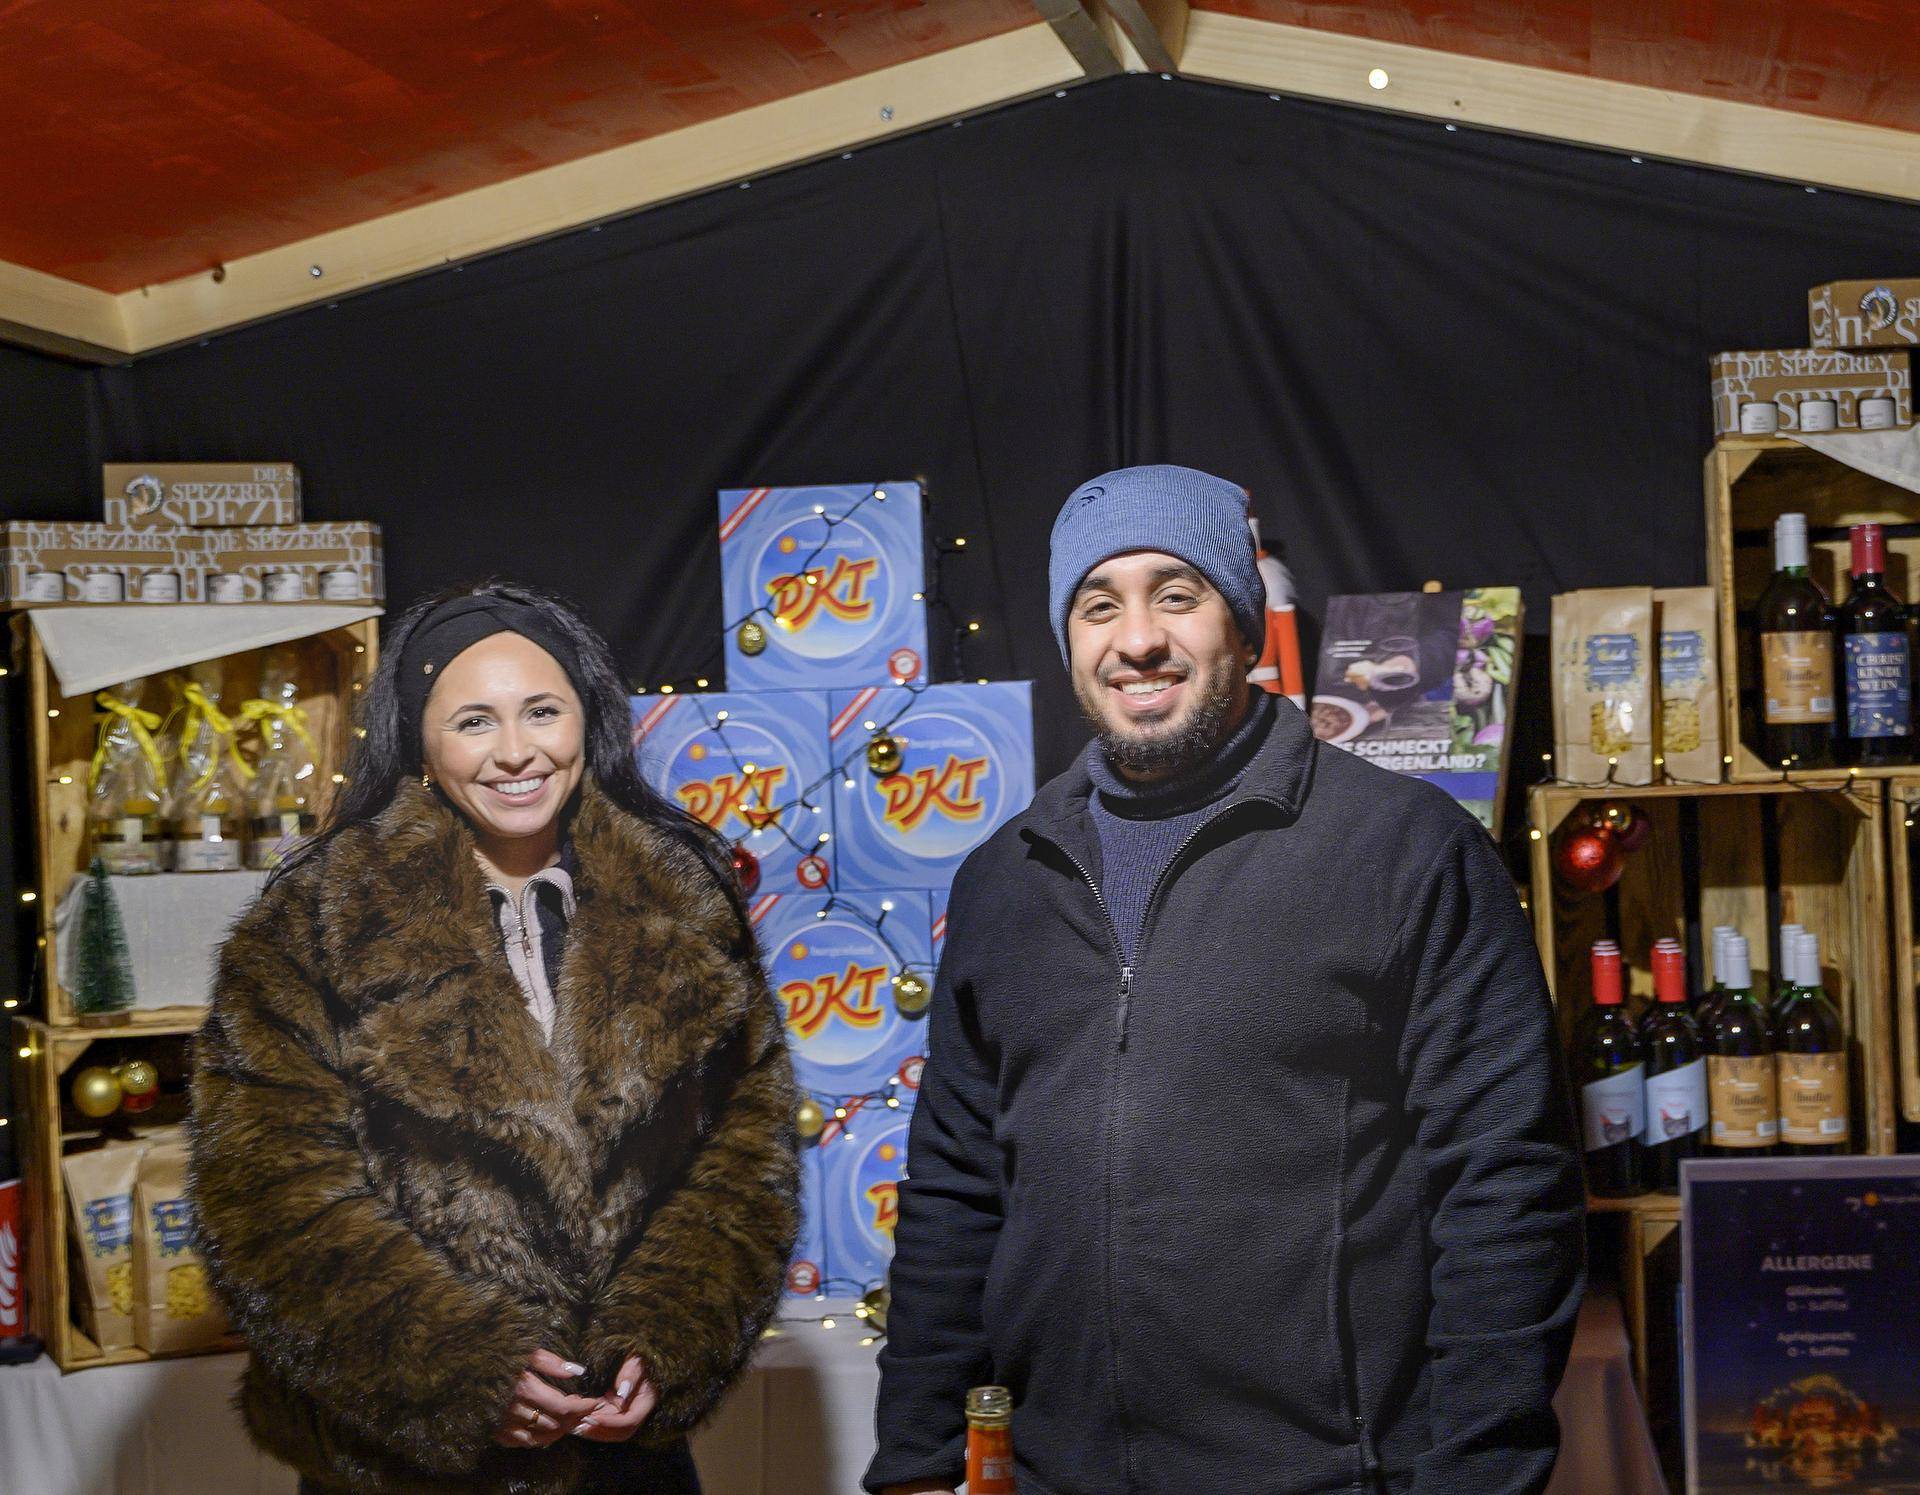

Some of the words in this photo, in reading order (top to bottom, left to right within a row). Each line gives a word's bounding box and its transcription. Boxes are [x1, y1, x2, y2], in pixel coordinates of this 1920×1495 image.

[1738, 357, 1777, 378] DIE
[1780, 354, 1895, 376] SPEZEREY
[171, 482, 286, 501] SPEZEREY
[26, 531, 65, 550] DIE
[71, 531, 178, 551] SPEZEREY
[245, 531, 353, 551] SPEZEREY
[766, 557, 877, 632] DKT
[1355, 739, 1451, 756] SCHMECKT
[677, 764, 787, 830] DKT
[878, 756, 986, 832] DKT
[779, 963, 887, 1038] DKT
[1762, 1255, 1872, 1271] ALLERGENE
